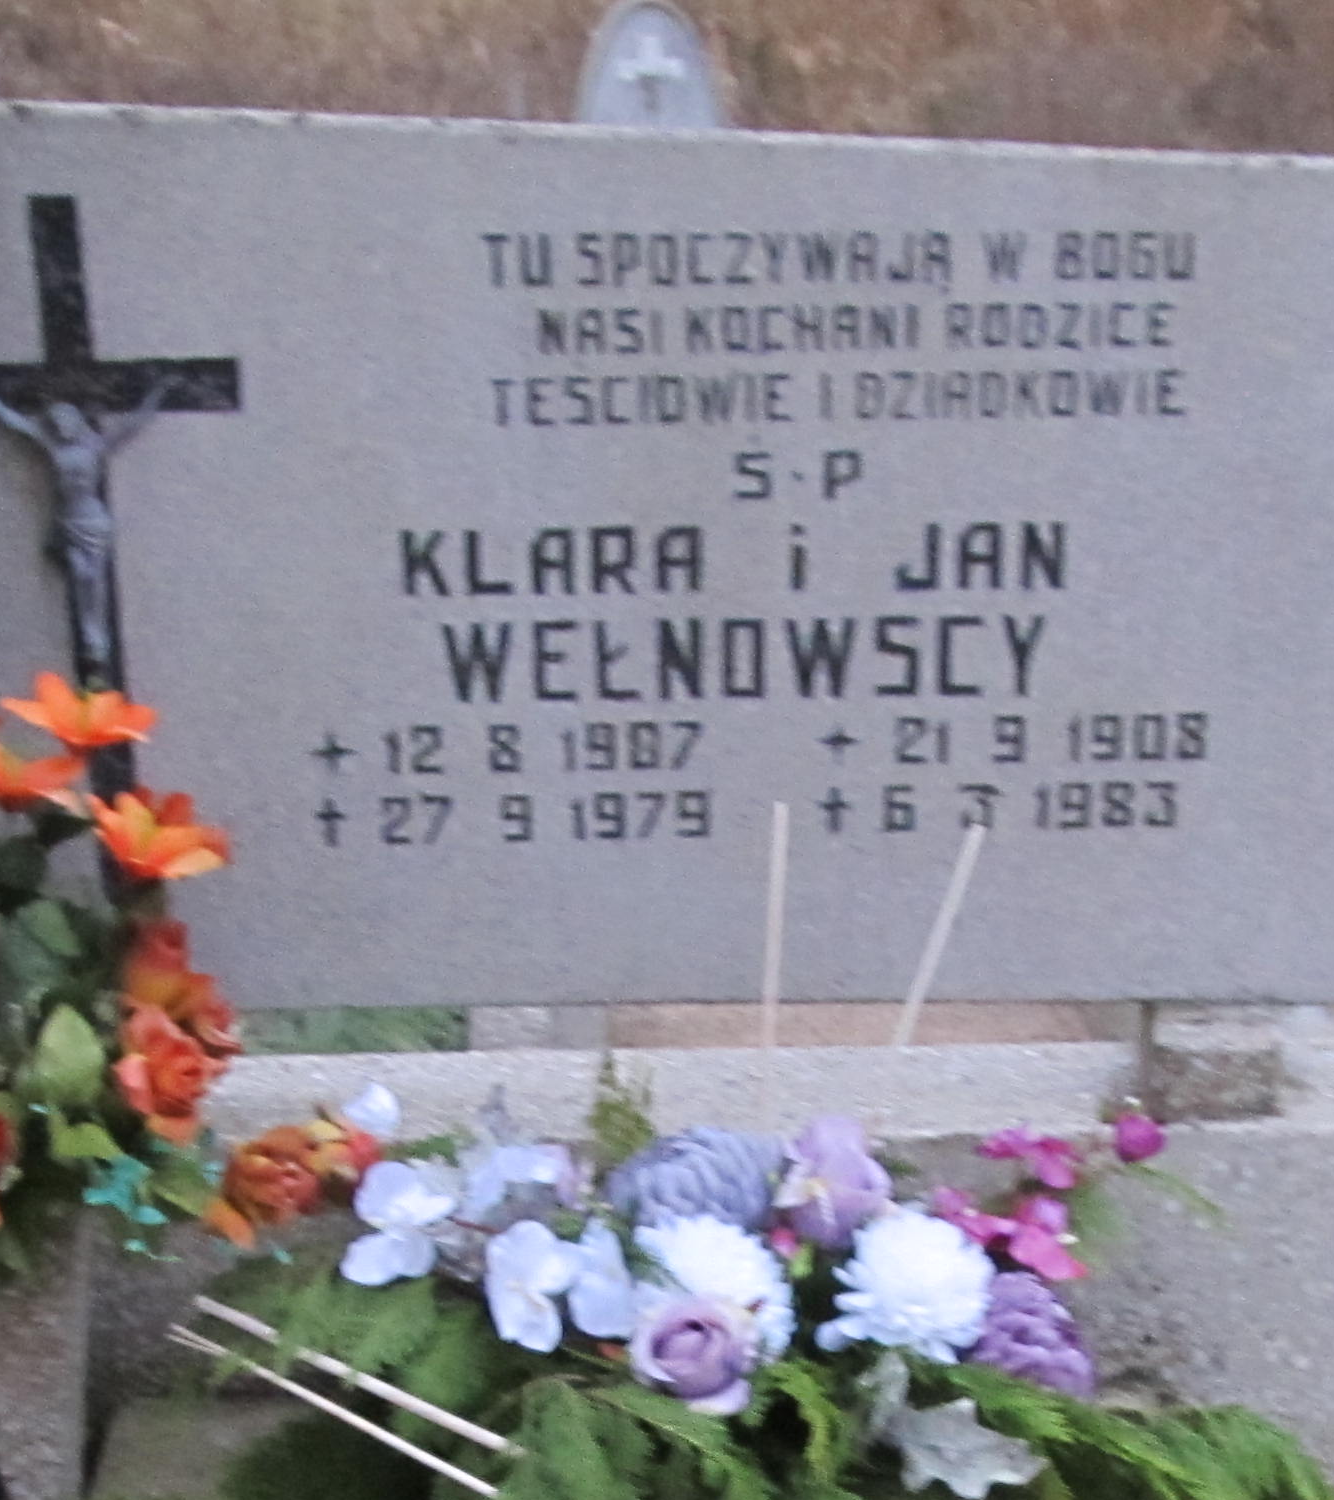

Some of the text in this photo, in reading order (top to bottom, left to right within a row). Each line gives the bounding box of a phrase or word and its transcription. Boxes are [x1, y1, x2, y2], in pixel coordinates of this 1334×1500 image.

[481, 232, 553, 286] TU
[982, 231, 1026, 284] W
[1055, 229, 1196, 282] BOGU
[537, 302, 1175, 354] NASI KOCHANI RODZICE
[818, 372, 833, 421] I
[854, 368, 1187, 420] DZIADKOWIE
[401, 520, 1067, 596] KLARA i JAN
[441, 613, 1046, 703] WEŁNOWSCY
[384, 724, 444, 774] 12
[488, 723, 521, 773] 8
[894, 711, 1208, 765] 21 9 1908
[380, 790, 710, 845] 27 9 1979
[882, 784, 914, 832] 6
[1036, 780, 1178, 829] 1983
